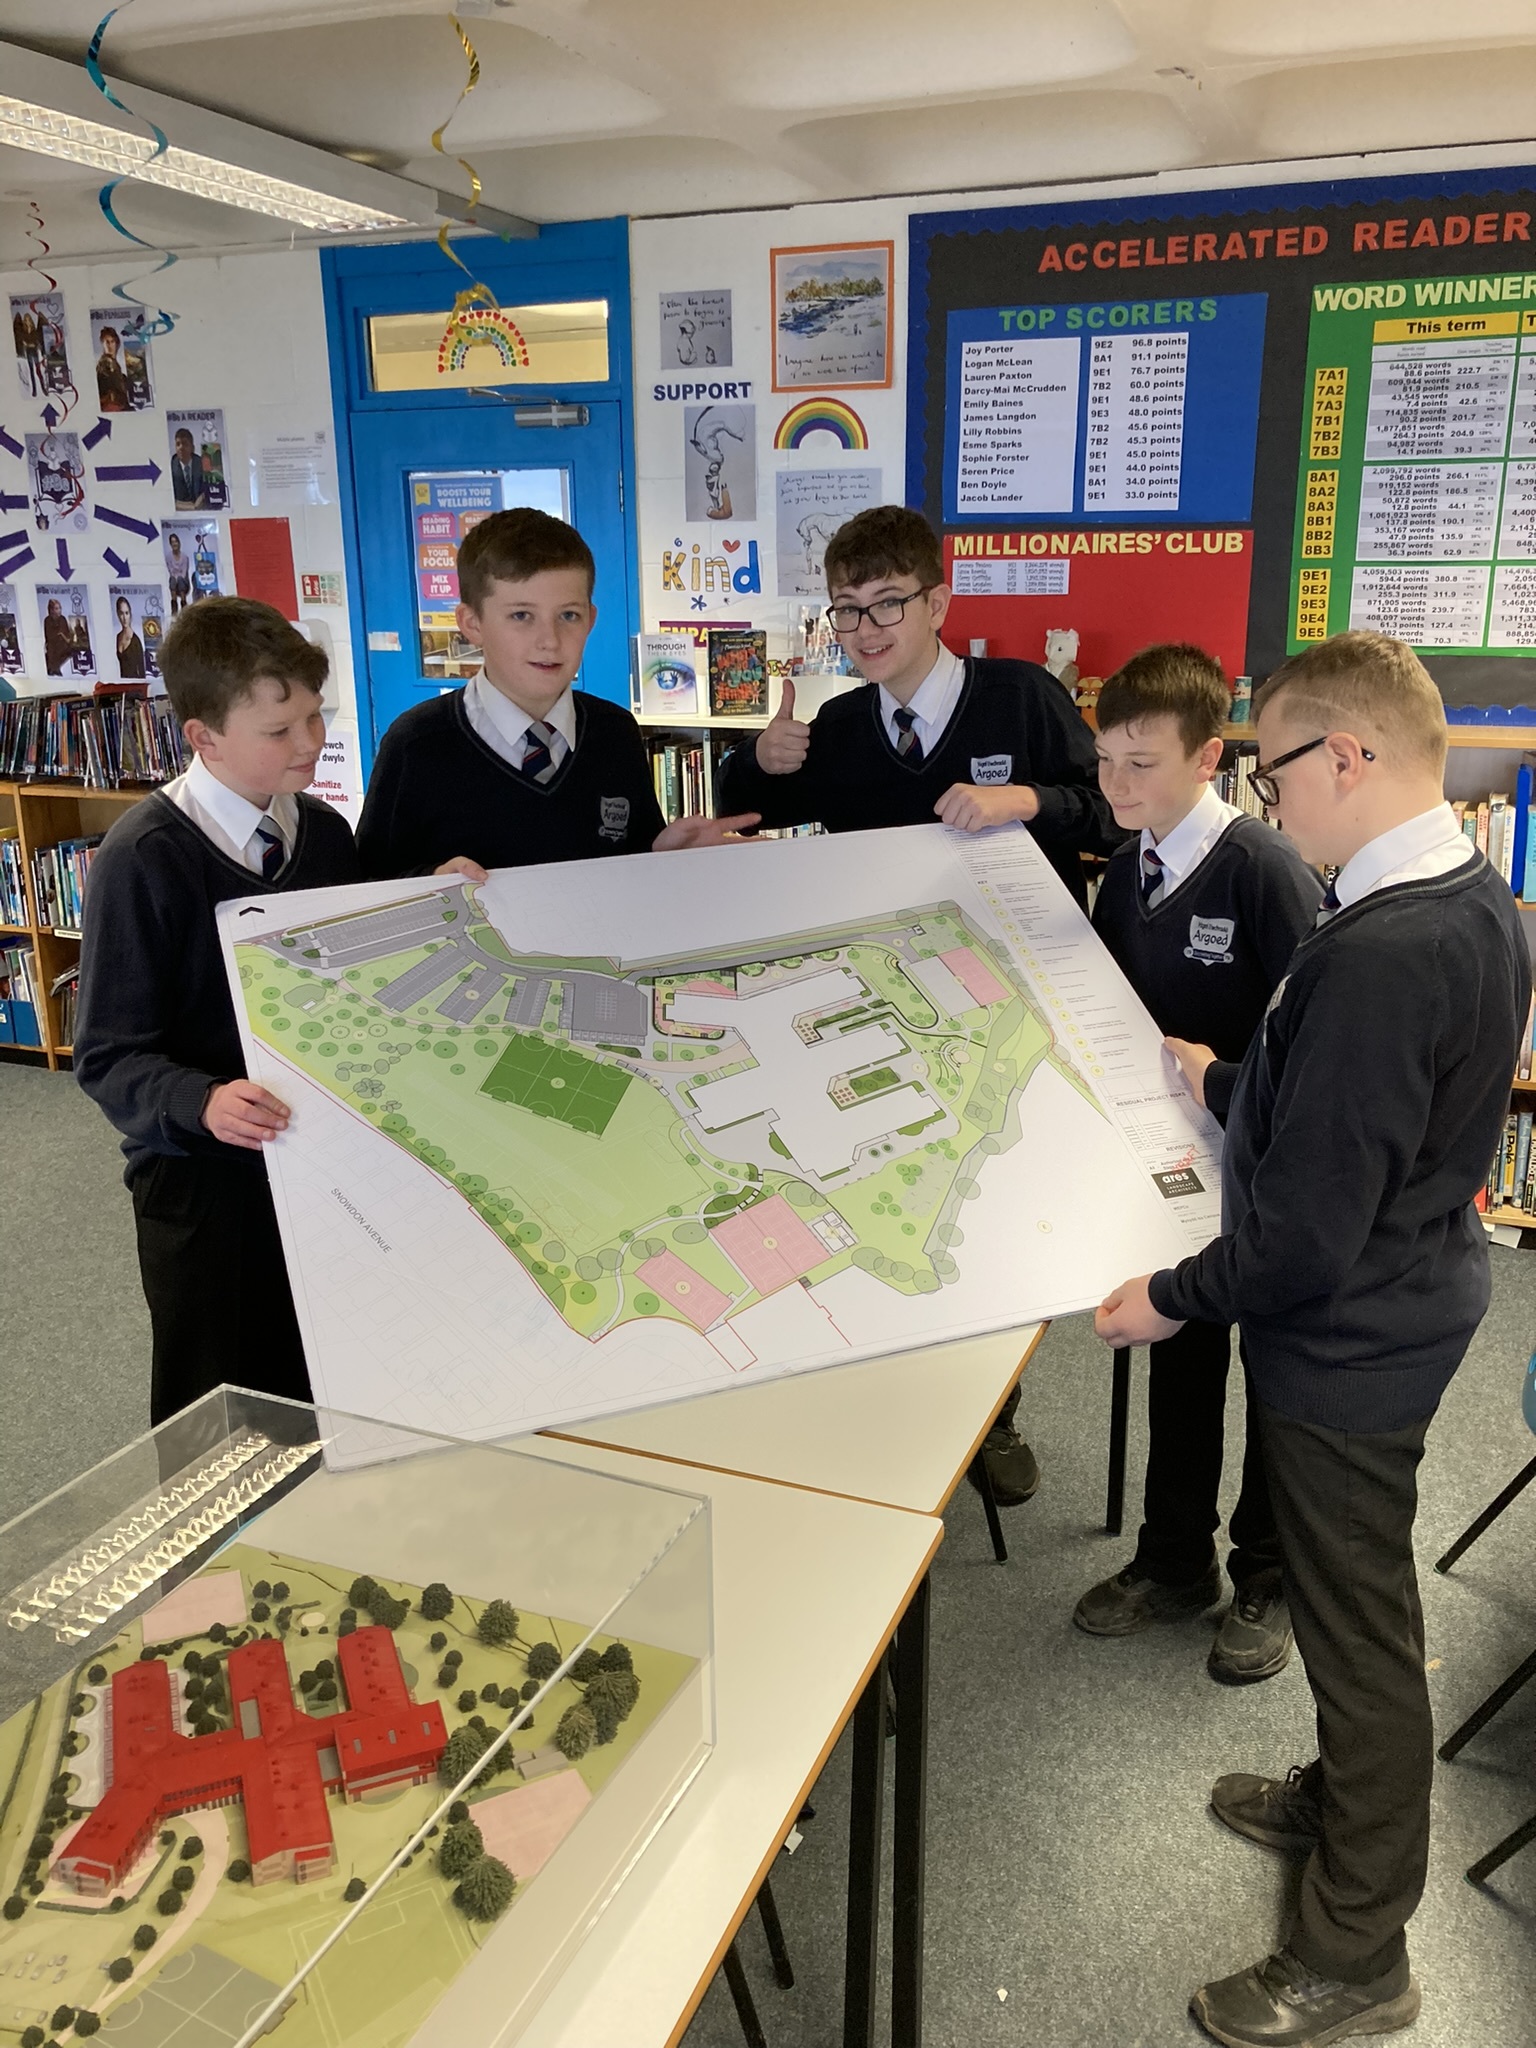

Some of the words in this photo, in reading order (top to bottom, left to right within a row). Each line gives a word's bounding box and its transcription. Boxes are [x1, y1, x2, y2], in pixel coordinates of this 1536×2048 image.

[1038, 226, 1328, 274] ACCELERATED
[1354, 212, 1532, 253] READER
[1314, 285, 1406, 312] WORD
[999, 309, 1055, 332] TOP
[1066, 299, 1218, 330] SCORERS
[1407, 322, 1441, 334] This
[1448, 320, 1486, 332] term
[1095, 341, 1113, 349] 9E2
[1132, 339, 1153, 347] 96.8
[1156, 337, 1187, 347] points
[966, 347, 981, 355] Joy
[1094, 354, 1112, 363] 8A1
[1132, 352, 1151, 361] 91.1
[1155, 352, 1186, 361] points
[965, 360, 994, 368] Logan
[997, 358, 1032, 366] McLean
[1094, 368, 1111, 376] 9E1
[1131, 367, 1151, 375] 76.7
[1154, 366, 1185, 375] points
[1319, 370, 1344, 381] 7A1
[965, 373, 996, 381] Lauren
[999, 372, 1032, 380] Paxton
[964, 386, 1010, 395] Darcy-Mai
[1013, 384, 1066, 393] McCrudden
[1093, 382, 1111, 390] 7B2
[1130, 381, 1150, 389] 60.0
[1153, 380, 1184, 389] points
[654, 382, 751, 400] SUPPORT
[1317, 386, 1344, 396] 7A2
[964, 401, 989, 409] Emily
[992, 399, 1023, 407] Baines
[1092, 396, 1109, 404] 9E1
[1129, 395, 1149, 403] 48.6
[1153, 394, 1183, 403] points
[1316, 401, 1343, 411] 7A3
[188, 412, 215, 421] READER
[964, 413, 993, 421] James
[997, 413, 1036, 422] Langdon
[1091, 410, 1109, 418] 9E3
[1151, 408, 1182, 418] points
[1315, 417, 1340, 426] 7B1
[964, 428, 982, 437] Lilly
[986, 427, 1022, 435] Robbins
[1091, 424, 1109, 432] 7B2
[1151, 422, 1182, 431] points
[1127, 436, 1148, 444] 45.3
[1150, 436, 1181, 445] points
[1314, 431, 1340, 441] 7B2
[990, 441, 1022, 450] Sparks
[1090, 451, 1107, 459] 9E1
[1127, 450, 1147, 458] 45.0
[1150, 450, 1180, 459] points
[1313, 447, 1339, 456] 7B3
[962, 454, 993, 463] Sophie
[997, 454, 1029, 462] Forster
[991, 467, 1014, 475] Price
[1089, 465, 1106, 473] 9E1
[1126, 464, 1146, 472] 44.0
[1150, 463, 1179, 473] points
[1088, 478, 1106, 486] 8A1
[1149, 477, 1179, 487] points
[1310, 472, 1336, 482] 8A1
[981, 480, 1007, 490] Doyle
[469, 488, 491, 496] YOUR
[1125, 491, 1145, 499] 33.0
[1148, 491, 1177, 500] points
[1309, 487, 1335, 497] 8A2
[438, 498, 491, 507] WELLBEING
[1308, 502, 1334, 511] 8A3
[1307, 516, 1332, 526] 8B1
[423, 525, 450, 534] HABIT
[1306, 531, 1332, 540] 8B2
[1165, 533, 1243, 554] CLUB
[428, 549, 448, 557] YOUR
[1305, 545, 1331, 555] 8B3
[424, 558, 454, 567] FOCUS
[663, 540, 761, 594] kind
[432, 575, 448, 583] MIX
[1303, 571, 1327, 581] 9E1
[431, 585, 438, 593] IT
[440, 585, 451, 593] UP
[1302, 585, 1327, 595] 9E2
[1301, 600, 1326, 609] 9E3
[1300, 614, 1325, 624] 9E4
[1299, 628, 1324, 637] 9E5
[322, 754, 344, 763] dwylo
[975, 766, 1008, 780] Argoed
[313, 780, 341, 788] Sanitize
[326, 793, 348, 802] hands
[1193, 930, 1228, 945] Argoed
[1116, 1098, 1143, 1107] RESIDUAL
[1144, 1094, 1168, 1102] PROJECT
[1166, 1143, 1195, 1151] REVISIONS
[1162, 1172, 1189, 1183] ares
[1166, 1182, 1194, 1190] LANDSCAPE
[1169, 1186, 1197, 1194] ARCHITECTS
[331, 1188, 366, 1225] SNOWDON
[363, 1224, 393, 1253] AVENUE
